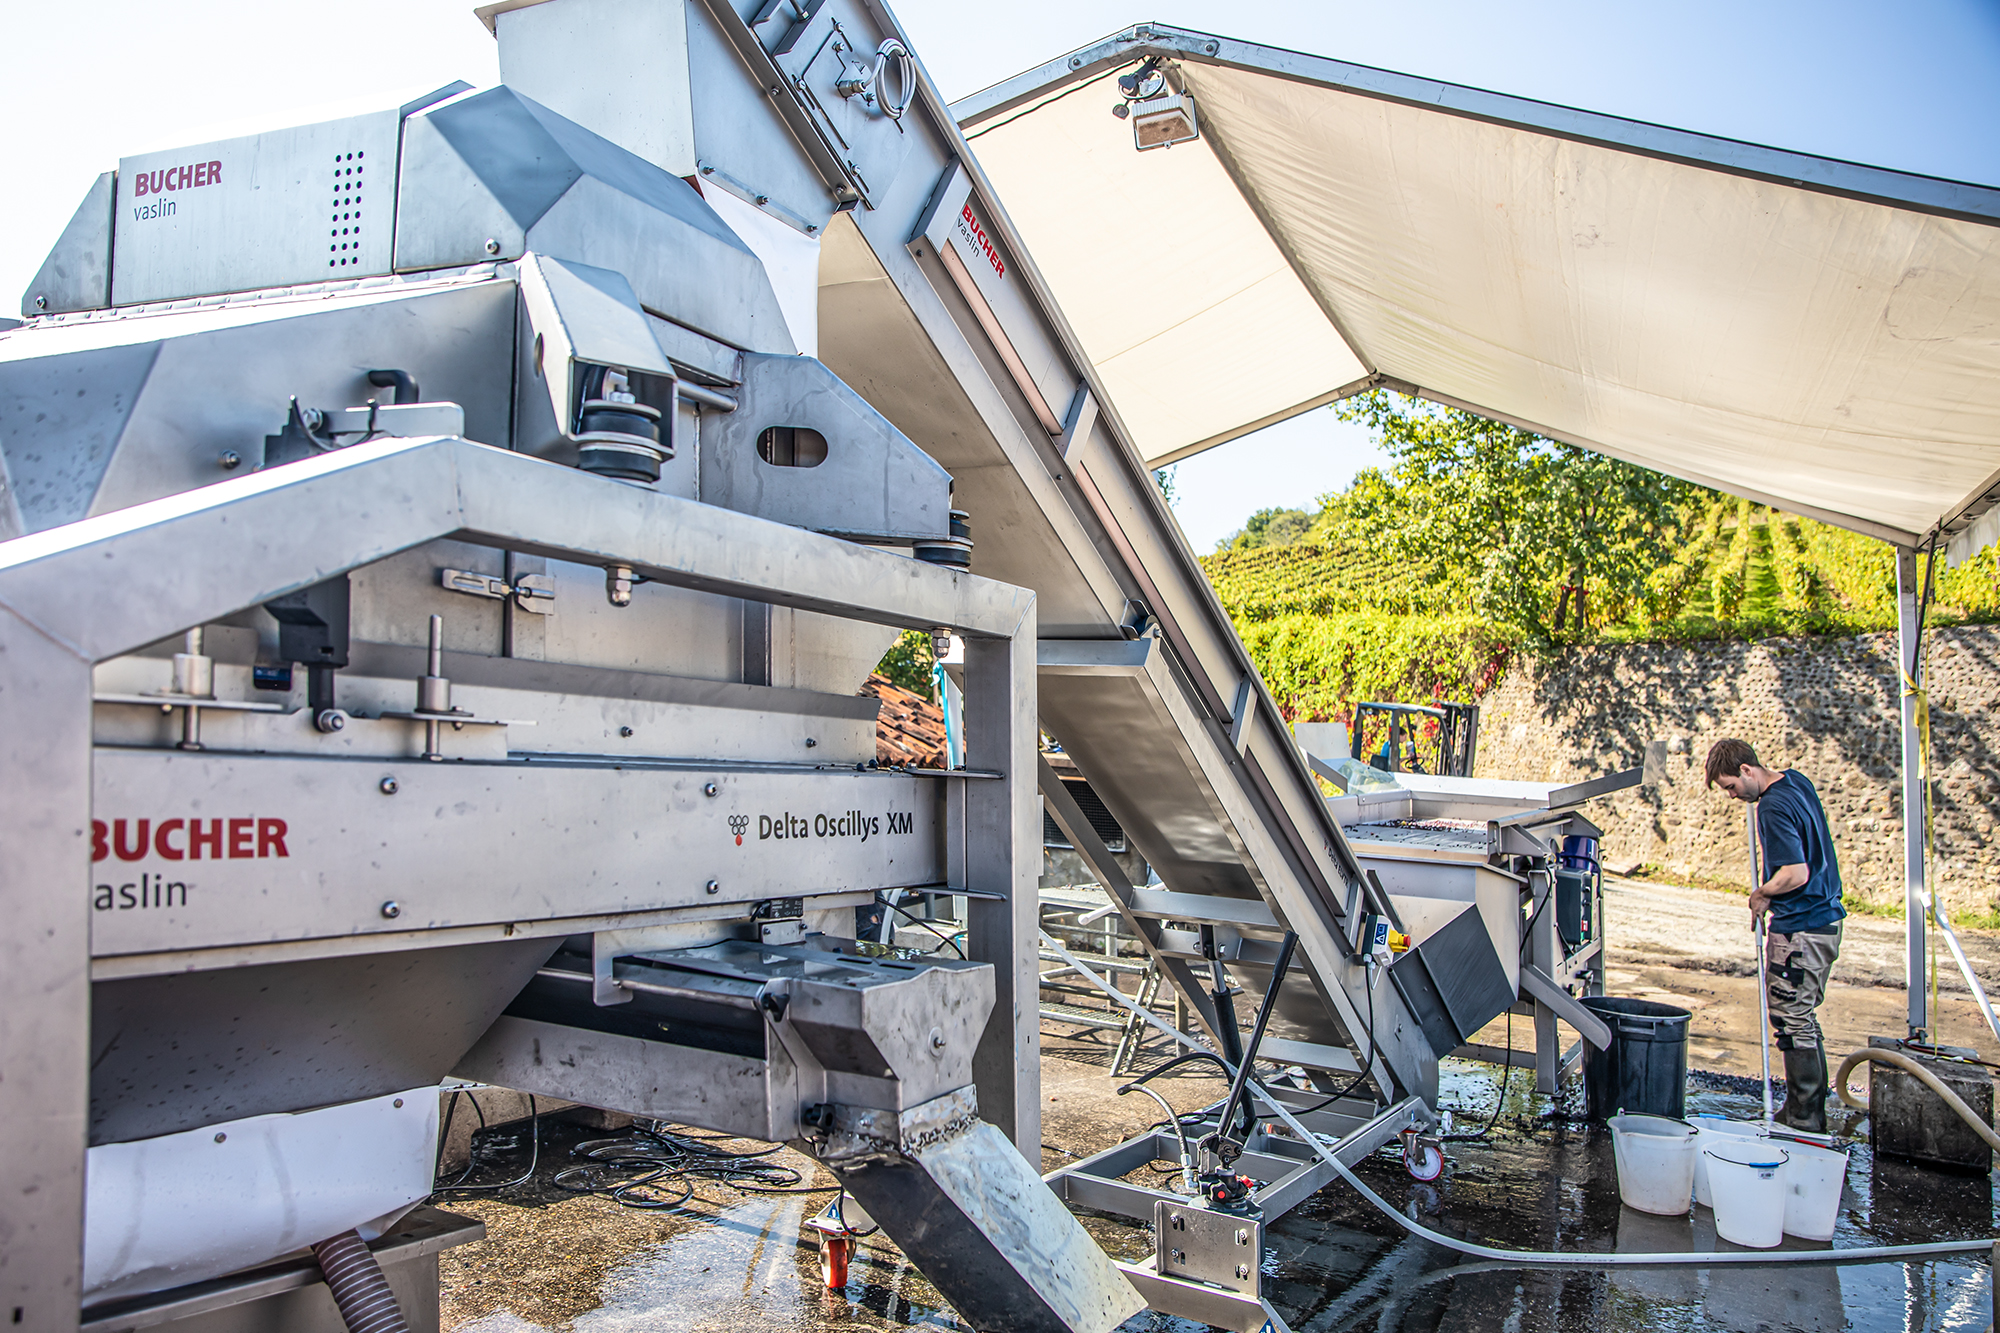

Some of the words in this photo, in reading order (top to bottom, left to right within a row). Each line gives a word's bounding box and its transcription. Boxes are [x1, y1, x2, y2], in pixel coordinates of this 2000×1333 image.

[135, 160, 222, 197] BUCHER
[133, 198, 177, 221] vaslin
[957, 218, 980, 258] vaslin
[962, 203, 1005, 280] BUCHER
[759, 811, 809, 840] Delta
[814, 810, 879, 843] Oscillys
[886, 812, 914, 835] XM
[93, 872, 188, 911] aslin
